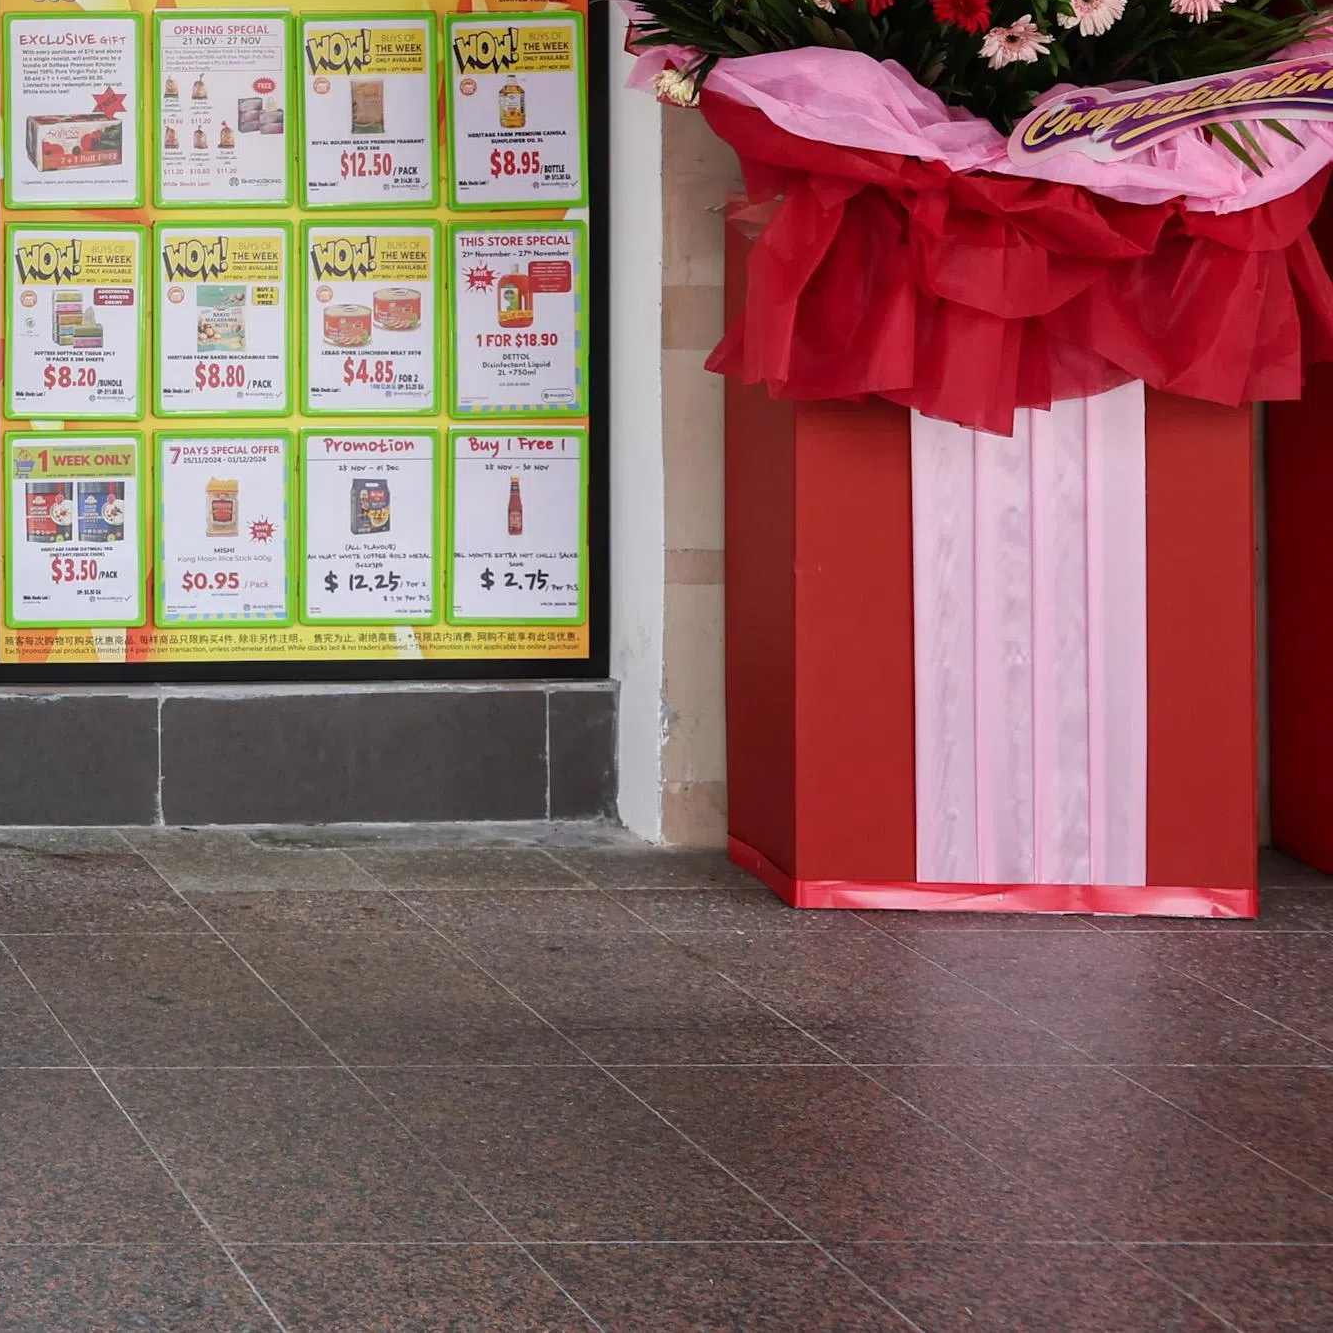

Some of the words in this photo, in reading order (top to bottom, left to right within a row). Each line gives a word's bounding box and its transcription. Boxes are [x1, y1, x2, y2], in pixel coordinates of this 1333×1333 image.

[19, 33, 96, 46] EXCLUSIVE
[174, 26, 223, 35] OPENING
[228, 25, 269, 34] SPECIAL
[196, 37, 216, 45] NOV
[227, 37, 237, 45] 27
[241, 37, 261, 45] NOV
[306, 28, 371, 76] WOW!
[394, 44, 422, 52] WEEK
[453, 27, 520, 74] WOW!
[523, 42, 540, 51] THE
[543, 42, 569, 50] WEEK
[340, 150, 392, 179] $12.50
[399, 167, 418, 175] PACK
[490, 149, 540, 178] $8.95
[460, 237, 484, 246] THIS
[488, 237, 523, 246] STORE
[527, 236, 570, 245] SPECIAL
[15, 239, 82, 285] WOW!
[104, 255, 132, 263] WEEK
[163, 236, 229, 282] WOW!
[251, 252, 278, 260] WEEK
[311, 235, 377, 281] WOW!
[476, 334, 481, 346] 1
[486, 334, 511, 347] FOR
[515, 333, 558, 348] $18.90
[44, 364, 96, 390] $8.20
[195, 361, 245, 391] $8.80
[253, 380, 272, 388] PACK
[343, 356, 393, 386] $4.85
[169, 447, 181, 464] 7
[183, 447, 208, 455] DAYS
[251, 446, 279, 454] OFFER
[323, 438, 415, 453] Promotion
[468, 437, 499, 458] Buy
[518, 437, 554, 451] Free
[38, 449, 48, 472] 1
[53, 455, 90, 466] WEEK
[94, 454, 131, 466] ONLY
[51, 557, 98, 584] $3.50
[182, 570, 239, 592] $0.95
[481, 567, 495, 590] $
[504, 569, 549, 591] 2.75
[325, 571, 339, 593] $
[349, 571, 401, 592] 12.25
